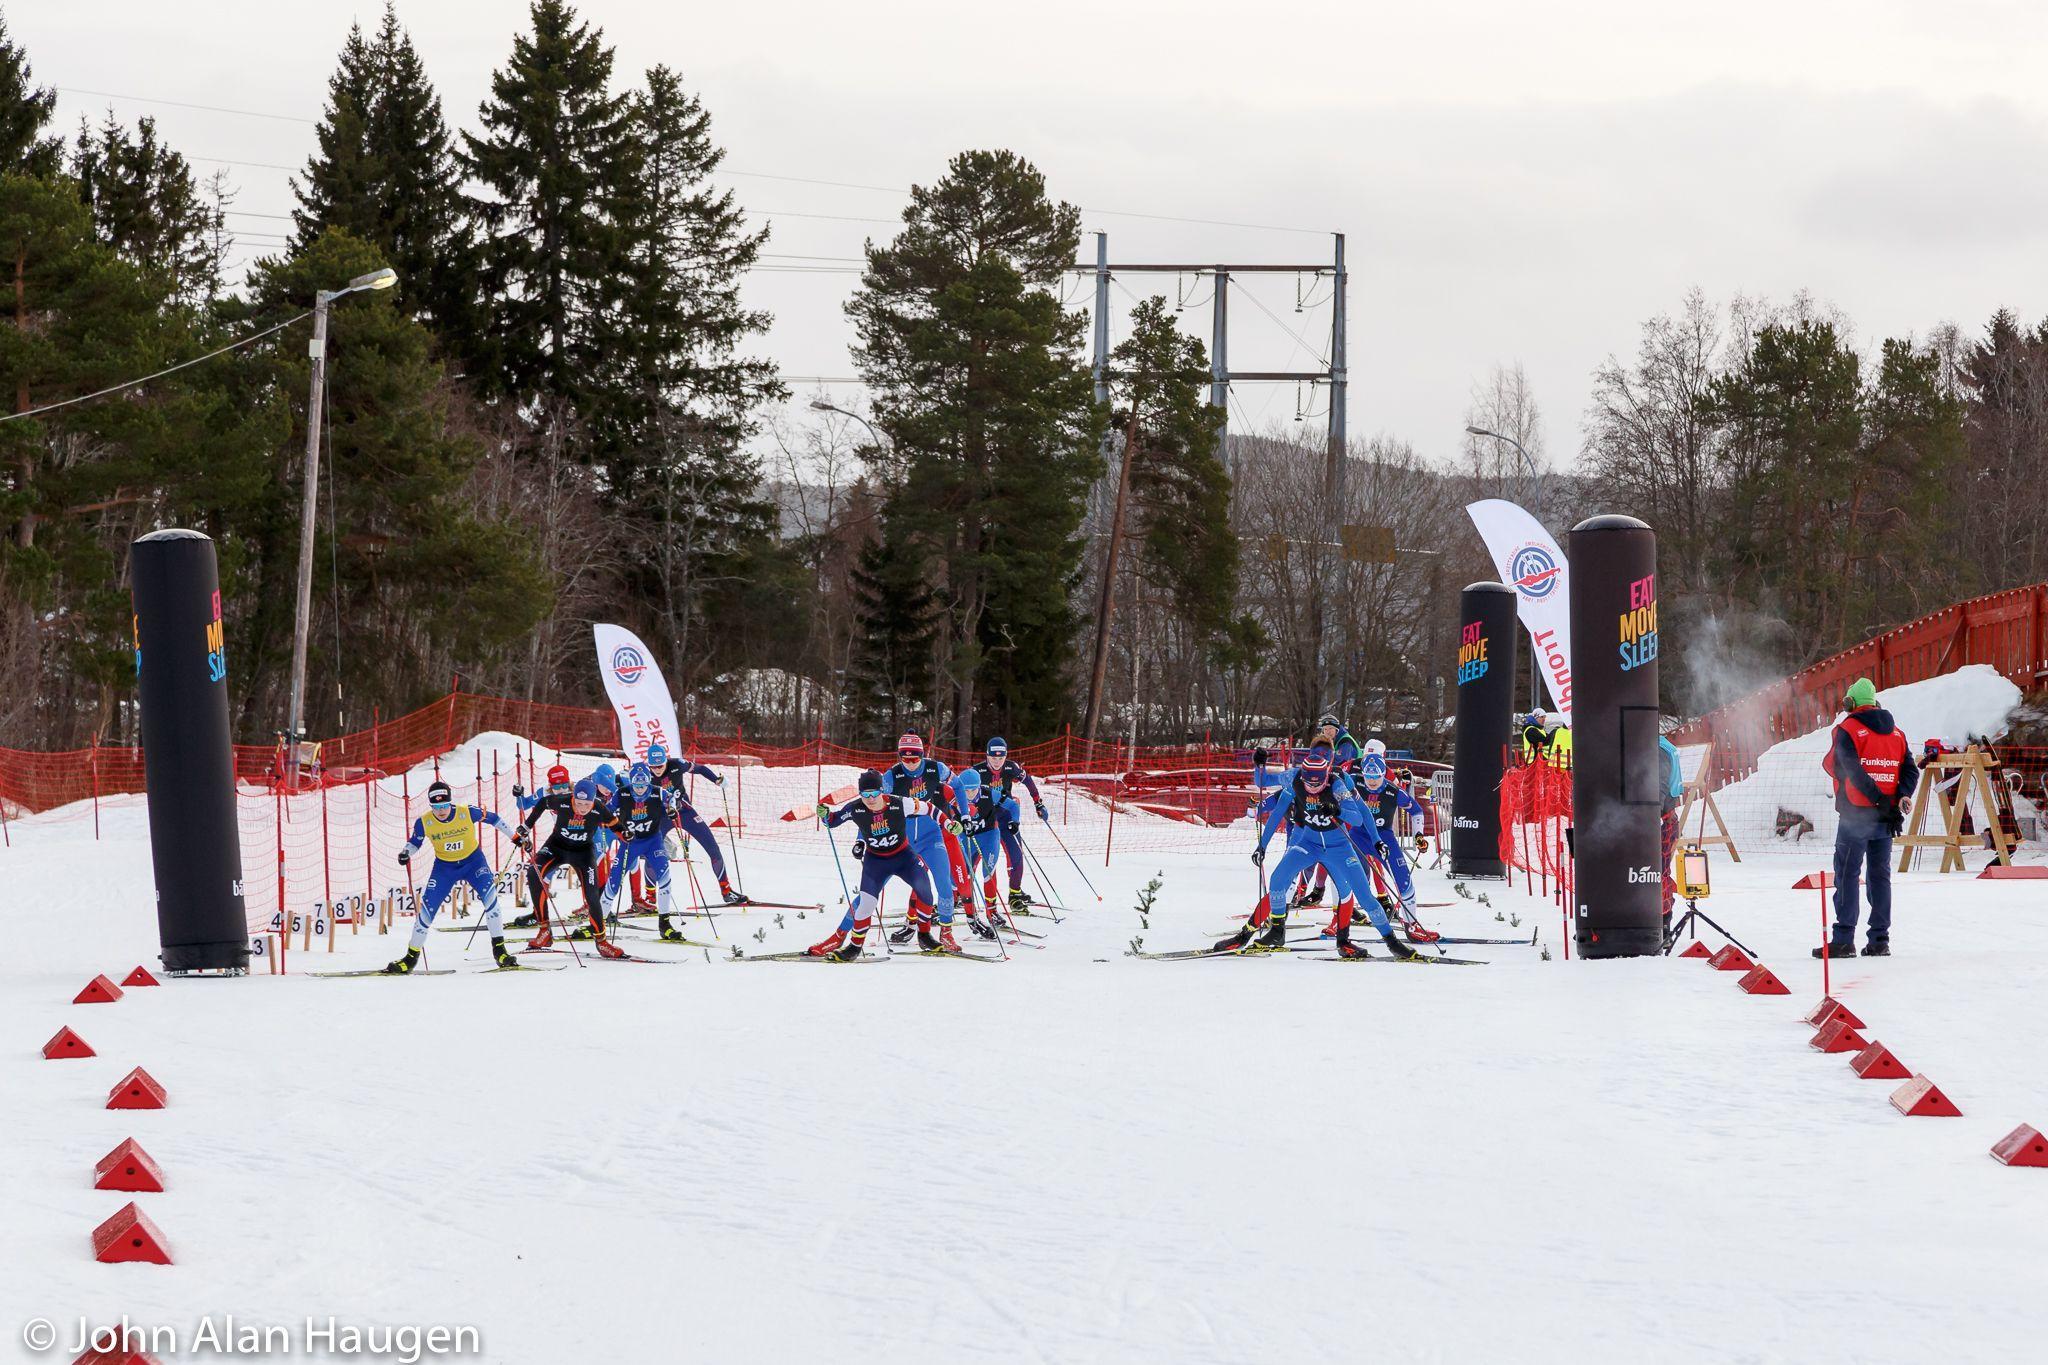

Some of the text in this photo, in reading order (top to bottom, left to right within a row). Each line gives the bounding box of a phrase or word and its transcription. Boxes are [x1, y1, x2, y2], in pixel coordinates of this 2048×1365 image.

[1630, 574, 1654, 611] EAT
[1462, 621, 1483, 644] EAT
[1458, 637, 1489, 667] MOVE
[1457, 660, 1489, 687] SLEEP
[626, 820, 653, 833] 247
[446, 842, 461, 850] 241
[868, 834, 899, 848] 242
[497, 881, 513, 894] 21
[315, 904, 323, 917] 7
[336, 902, 345, 917] 8
[366, 902, 375, 917] 9
[397, 896, 415, 911] 12
[271, 912, 281, 928] 4
[291, 916, 301, 932] 5
[315, 919, 324, 934] 6
[253, 939, 263, 955] 3
